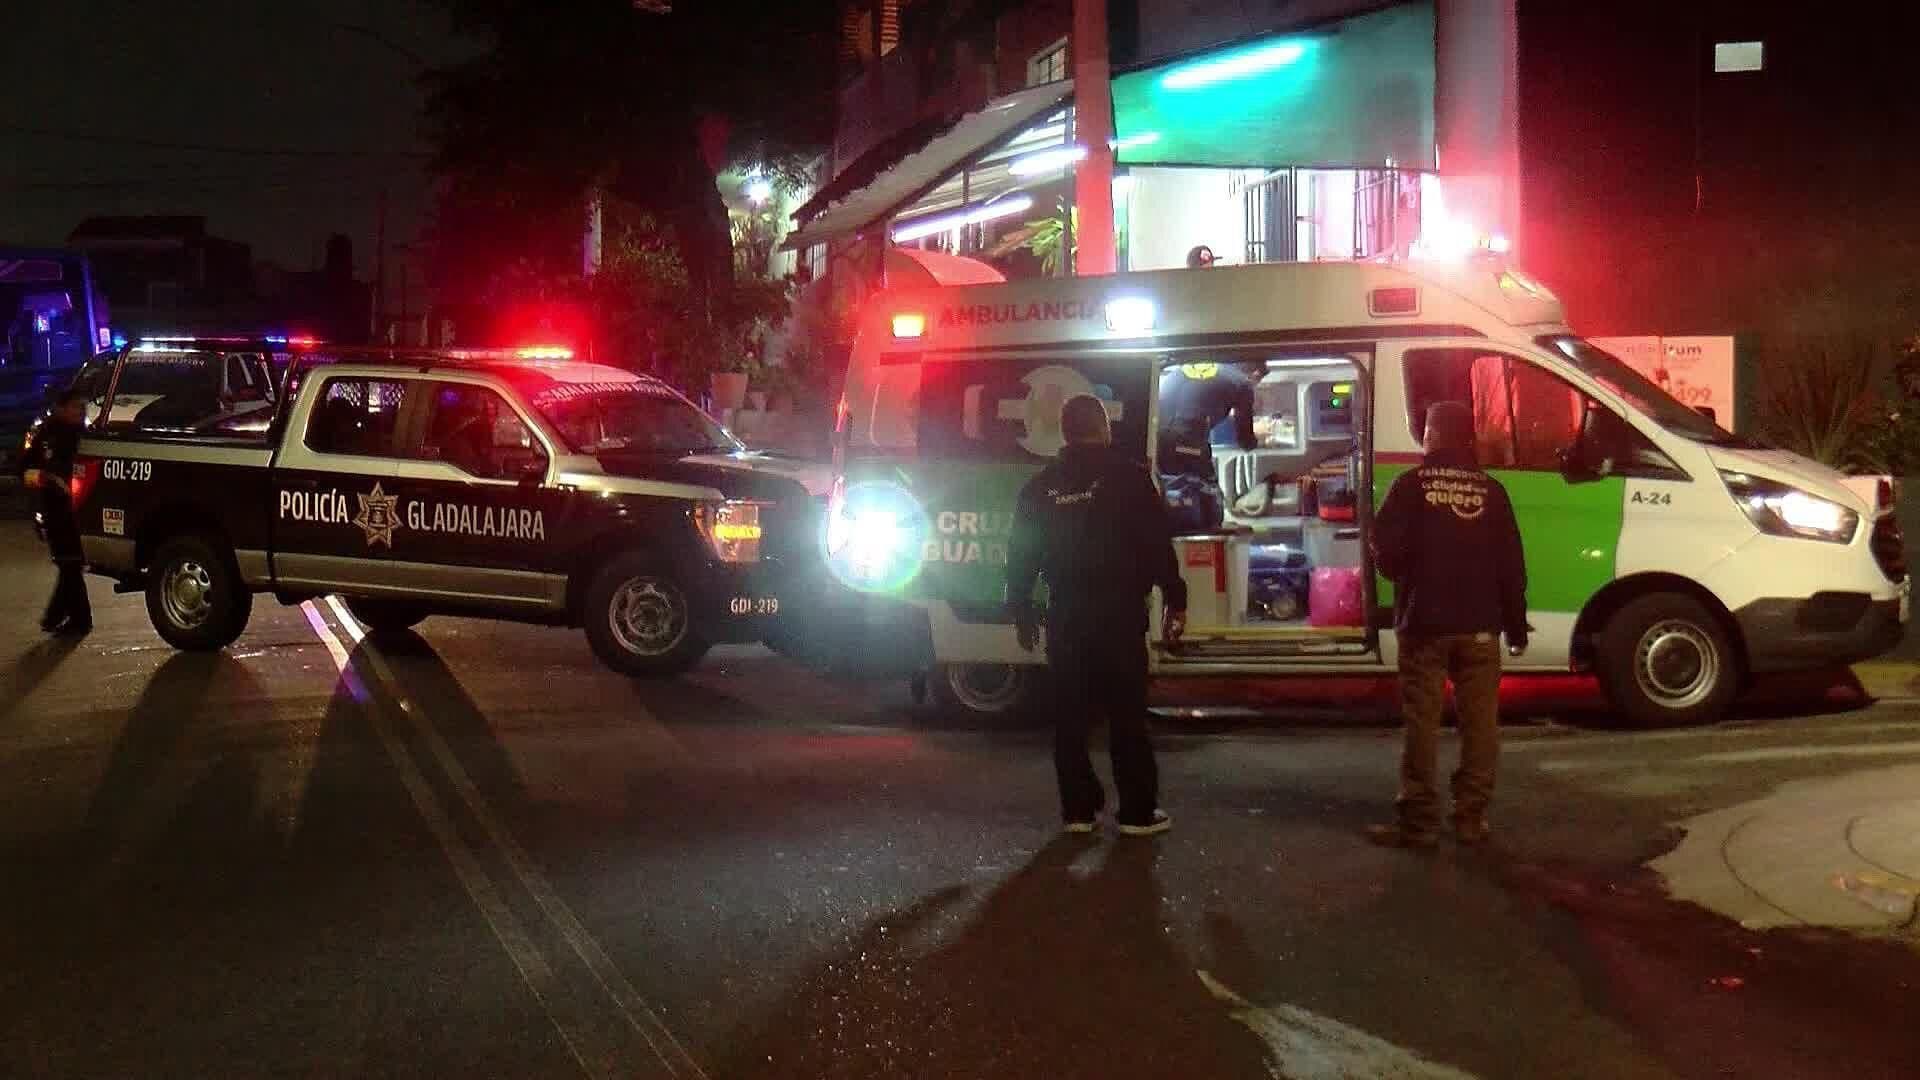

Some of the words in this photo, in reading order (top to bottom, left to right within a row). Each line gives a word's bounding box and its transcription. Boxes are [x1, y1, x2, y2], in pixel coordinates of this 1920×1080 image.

[104, 459, 152, 481] GDL-219
[280, 488, 349, 524] POLICÍA
[1425, 490, 1483, 508] quiero
[1631, 490, 1671, 506] A-24
[730, 597, 778, 613] GDL-219
